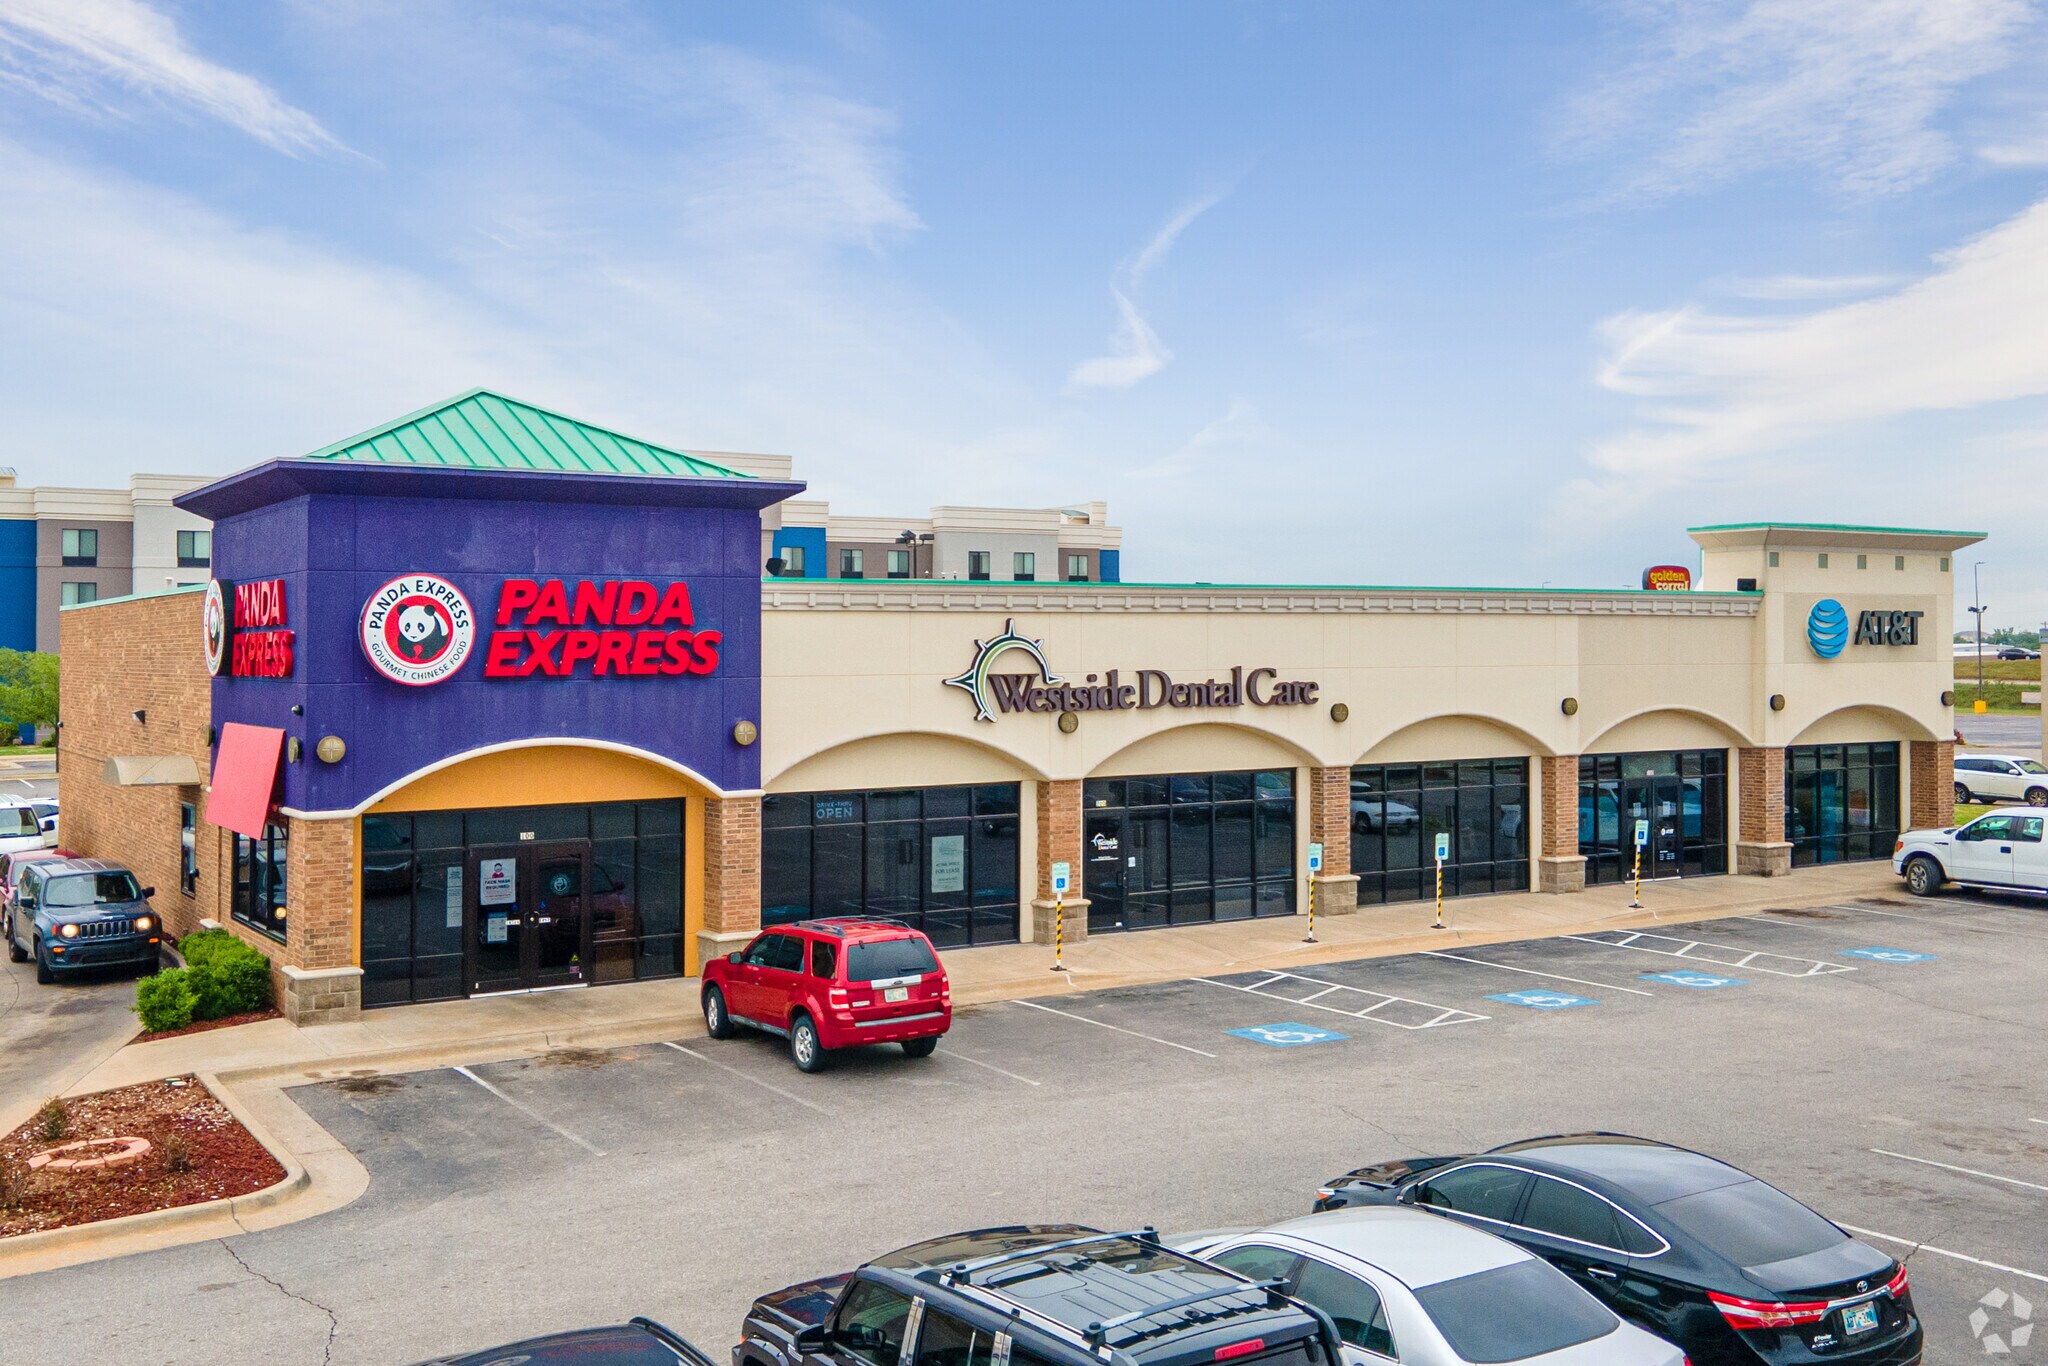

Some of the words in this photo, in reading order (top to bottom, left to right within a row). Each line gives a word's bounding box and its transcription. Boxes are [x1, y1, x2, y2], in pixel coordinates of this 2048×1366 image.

[1650, 570, 1685, 584] golden
[1656, 580, 1689, 591] corral
[234, 579, 287, 628] PANDA
[369, 583, 410, 629] PANDA
[415, 580, 469, 629] EXPRESS
[496, 579, 694, 626] PANDA
[1853, 609, 1924, 646] AT&T
[231, 629, 295, 678] EXPRESS
[371, 643, 408, 678] GOURMET
[411, 663, 450, 680] CHINESE
[450, 640, 467, 666] FOOD
[484, 629, 723, 677] EXPRESS
[987, 668, 1137, 713] Westside
[1135, 666, 1245, 709] Dental
[1246, 667, 1320, 706] Care
[816, 808, 853, 819] OPEN
[520, 832, 534, 840] 100
